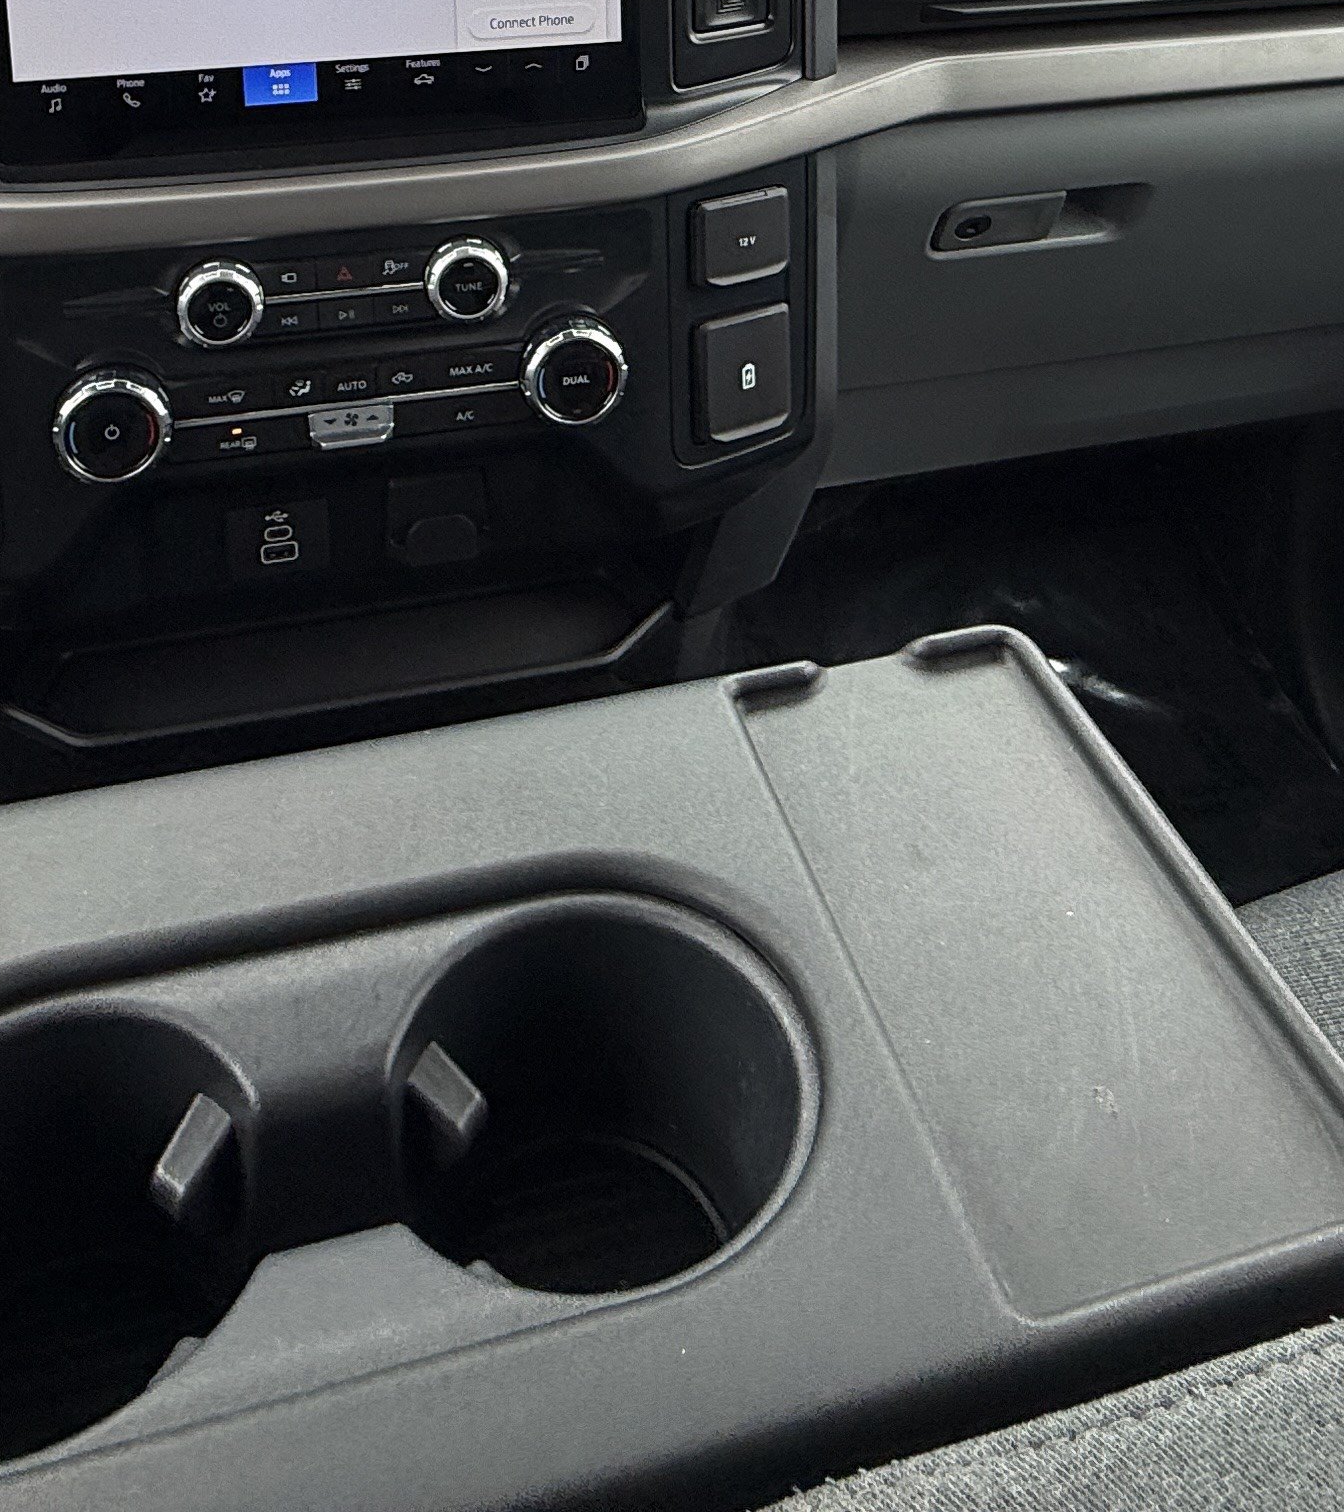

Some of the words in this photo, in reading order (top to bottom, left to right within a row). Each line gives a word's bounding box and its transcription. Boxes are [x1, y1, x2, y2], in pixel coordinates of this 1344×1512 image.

[489, 17, 537, 30] Connect
[538, 14, 575, 26] Phone
[335, 63, 370, 74] Settings
[406, 59, 441, 68] Features
[198, 73, 214, 83] Fav
[269, 68, 291, 79] Apps
[41, 84, 67, 93] Audio
[116, 78, 145, 88] Phone
[456, 281, 483, 292] TUNE
[207, 302, 231, 312] VOL
[449, 365, 473, 376] MAX
[475, 363, 494, 374] A/C
[337, 380, 367, 391] AUTO
[562, 375, 590, 386] DUAL
[208, 395, 227, 403] MAX
[456, 410, 475, 421] A/C
